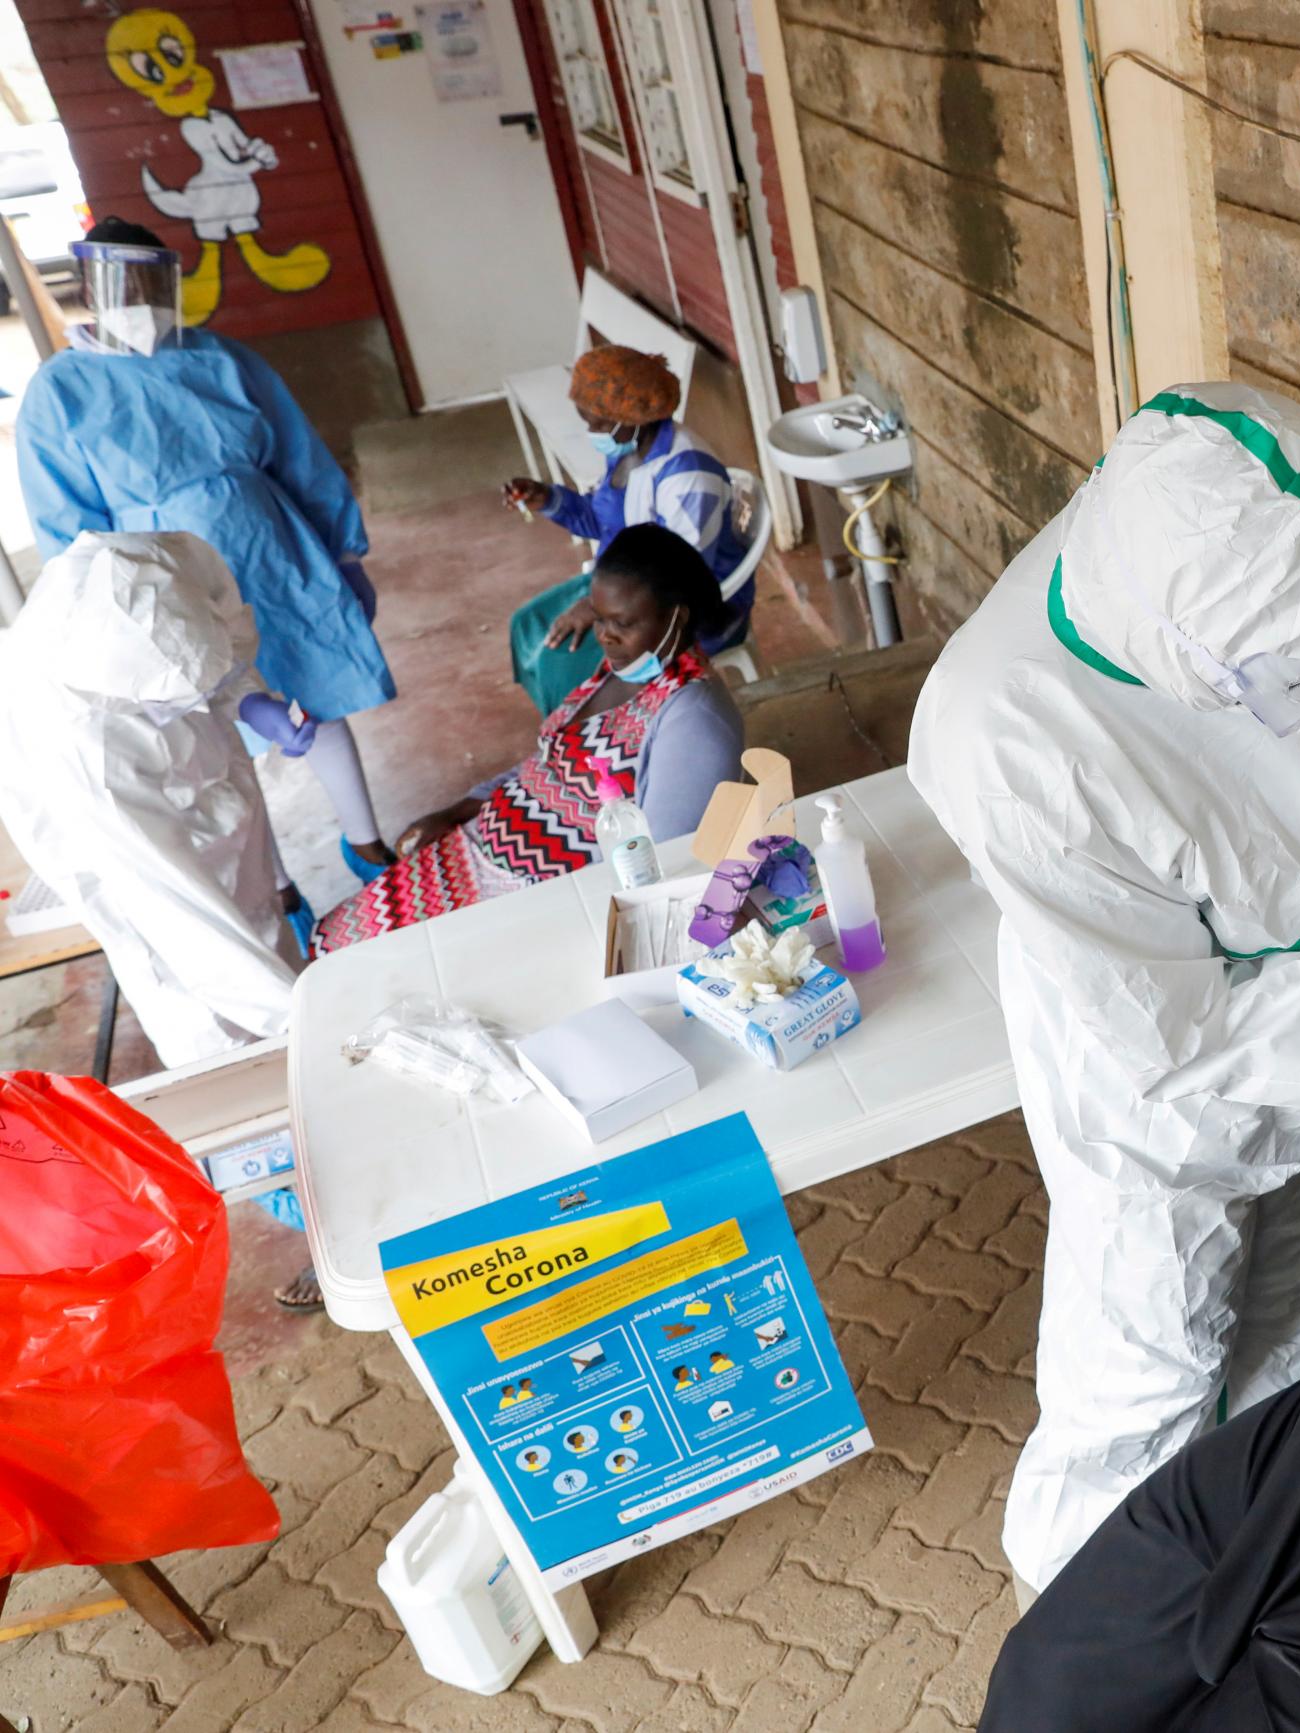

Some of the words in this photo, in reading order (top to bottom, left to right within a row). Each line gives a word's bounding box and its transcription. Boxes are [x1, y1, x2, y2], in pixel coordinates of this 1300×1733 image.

[783, 1012, 814, 1037] GREAT
[815, 991, 845, 1014] GLOVE
[412, 1246, 528, 1300] Komesha
[485, 1246, 589, 1295] Corona
[633, 1309, 651, 1322] Jinsi
[466, 1382, 487, 1397] Jinsi
[827, 1442, 853, 1460] CDC
[638, 1501, 661, 1514] Piga
[664, 1491, 683, 1504] 719
[698, 1466, 741, 1488] bonyeza
[763, 1471, 798, 1491] USAID
